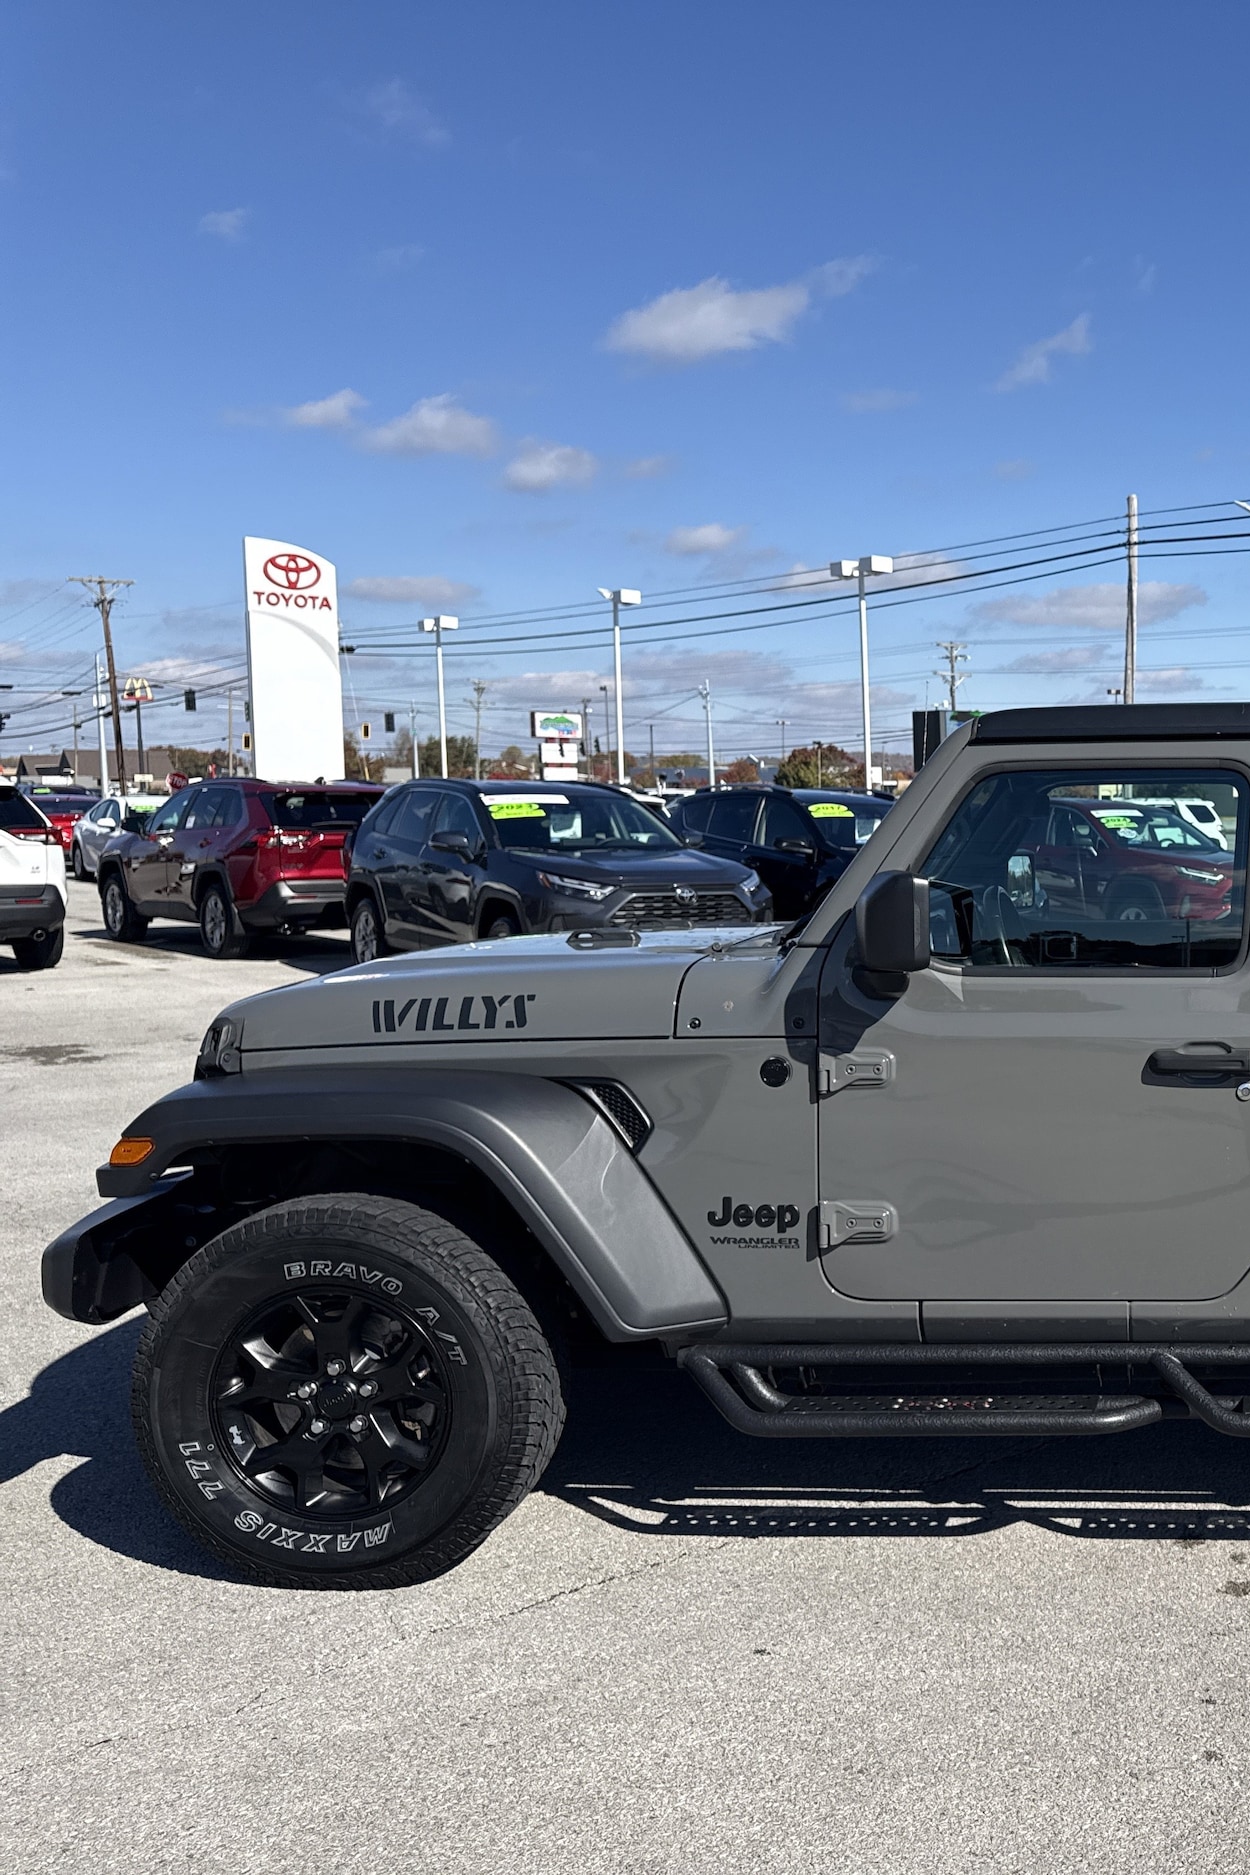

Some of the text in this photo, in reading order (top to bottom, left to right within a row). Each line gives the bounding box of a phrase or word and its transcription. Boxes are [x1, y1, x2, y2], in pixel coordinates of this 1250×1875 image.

[253, 591, 332, 611] TOYOTA
[372, 994, 536, 1033] WILLYS
[707, 1196, 800, 1233] Jeep
[709, 1236, 800, 1245] WRANGLER
[283, 1260, 467, 1365] BRAVO A/T
[178, 1441, 392, 1553] MAXXIS 771
